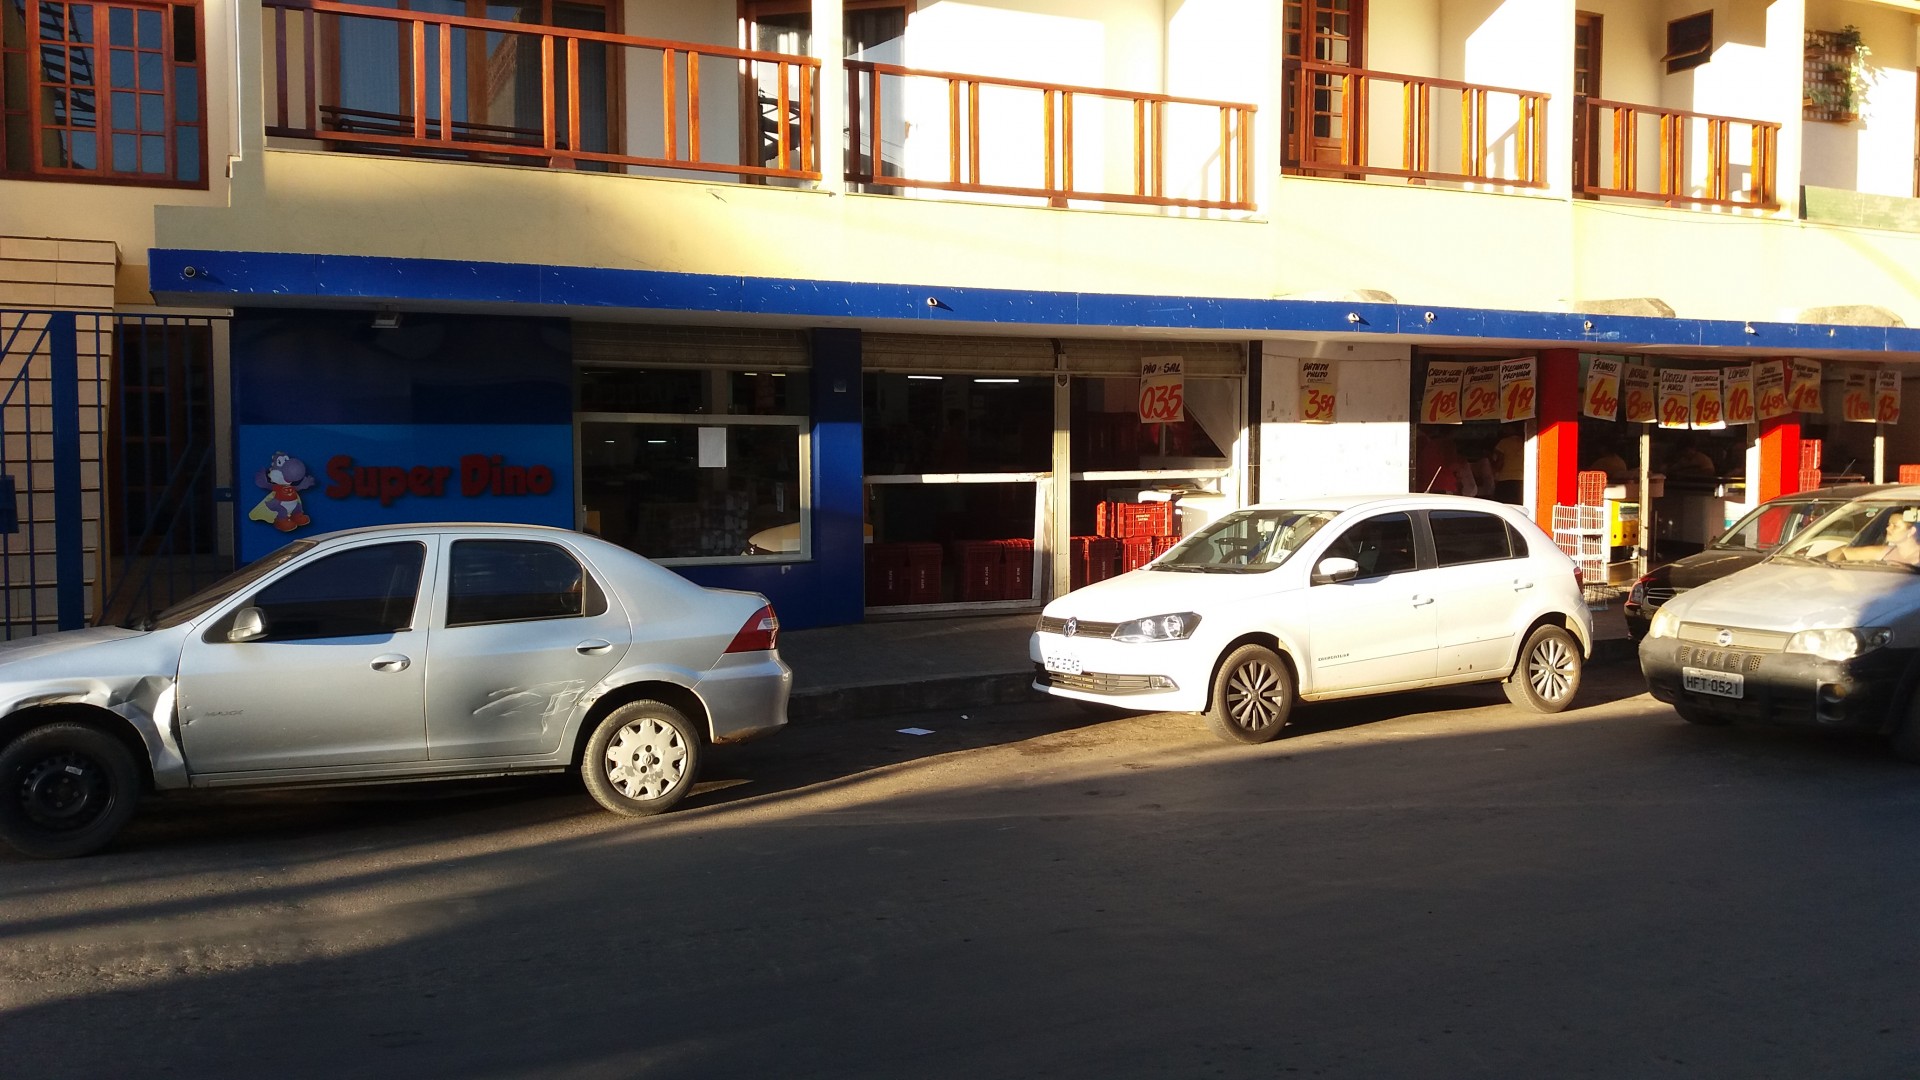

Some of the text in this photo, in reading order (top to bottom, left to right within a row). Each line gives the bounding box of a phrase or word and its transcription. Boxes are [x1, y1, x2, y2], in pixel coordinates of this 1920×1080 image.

[1163, 362, 1181, 373] SAL
[1303, 362, 1330, 371] BATATA
[1592, 358, 1617, 372] FRANGO
[1661, 370, 1687, 383] COSTELA
[1728, 368, 1750, 380] LOMBO
[326, 453, 553, 507] Super Dino
